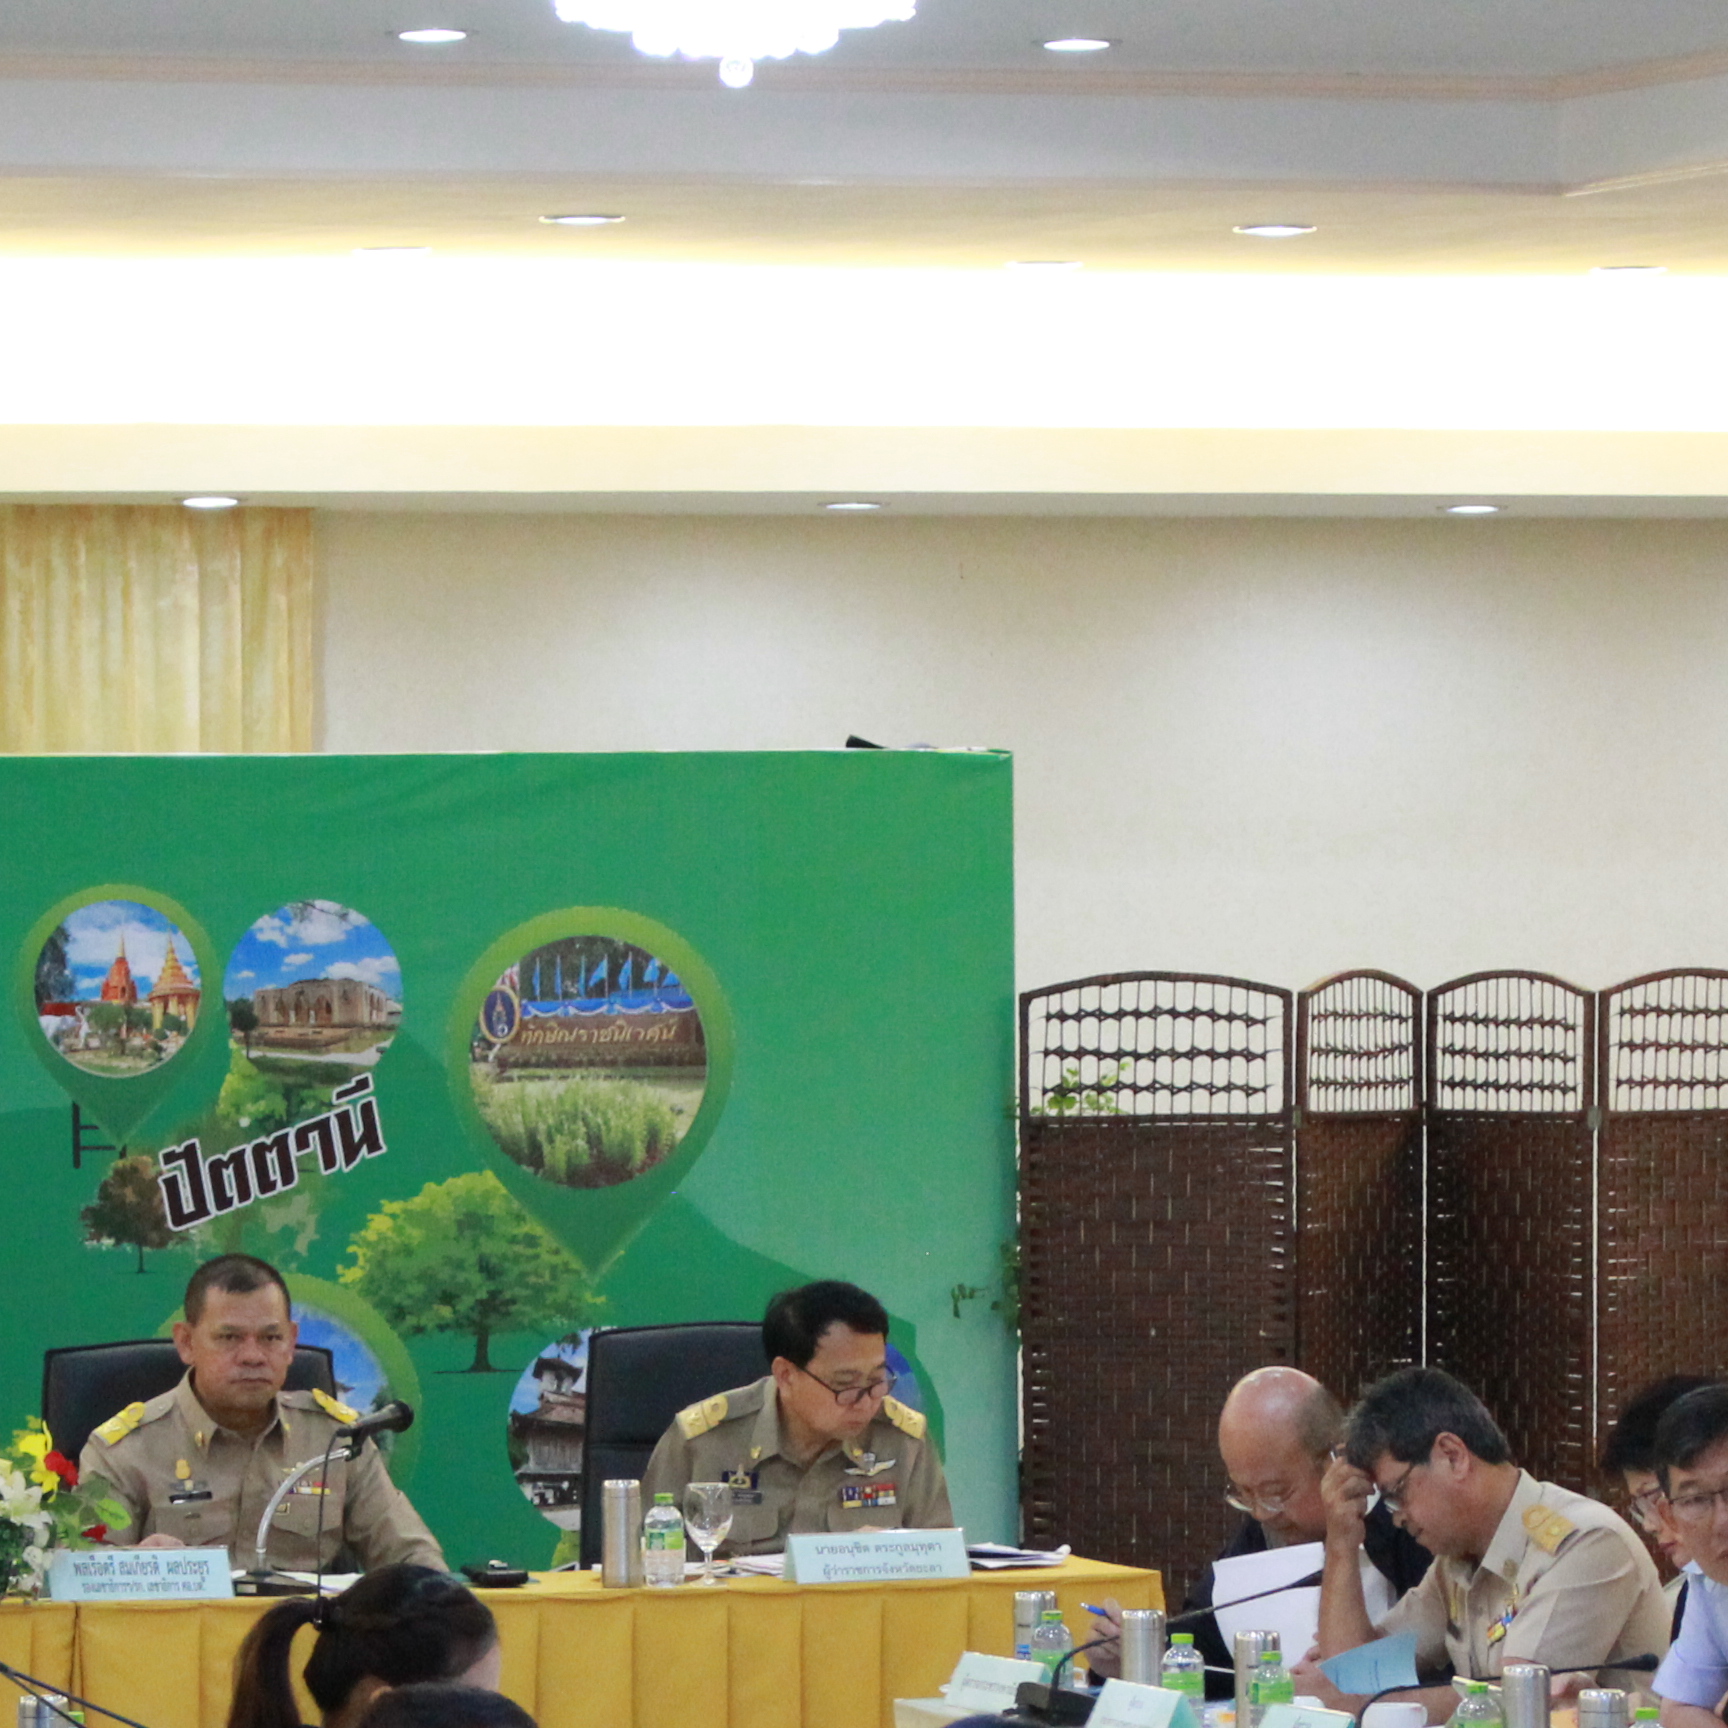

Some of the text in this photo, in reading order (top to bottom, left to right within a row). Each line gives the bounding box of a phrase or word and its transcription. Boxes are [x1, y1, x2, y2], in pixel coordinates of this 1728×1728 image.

[158, 1072, 387, 1231] ปัตตานี
[74, 1555, 116, 1576] พลเรือตรี
[118, 1555, 160, 1576] สมเกียรติ
